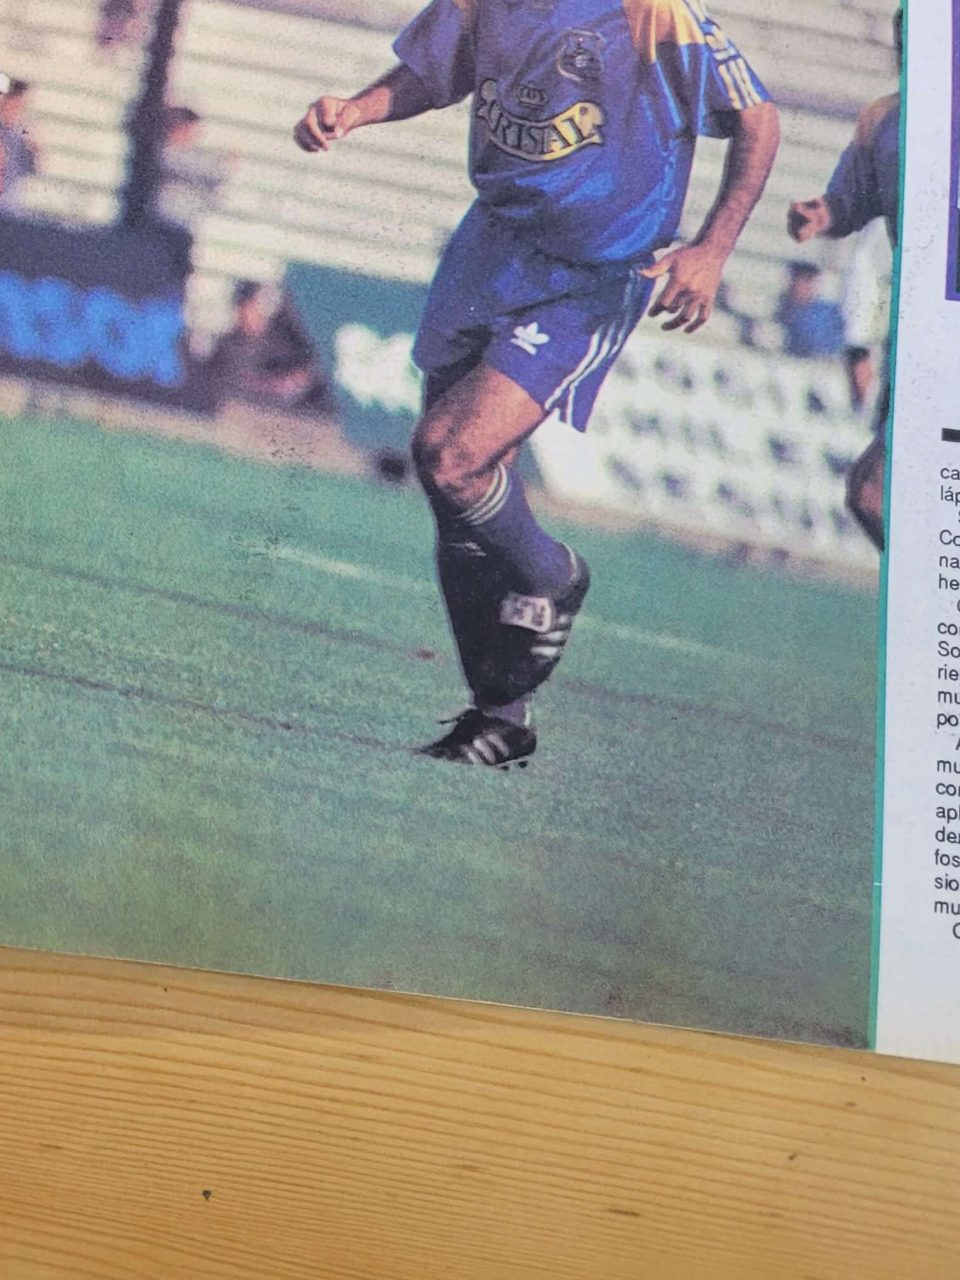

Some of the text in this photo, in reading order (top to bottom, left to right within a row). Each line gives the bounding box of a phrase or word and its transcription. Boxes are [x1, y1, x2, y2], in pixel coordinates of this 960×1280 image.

[937, 622, 960, 636] co
[935, 782, 960, 797] co
[935, 826, 960, 844] de
